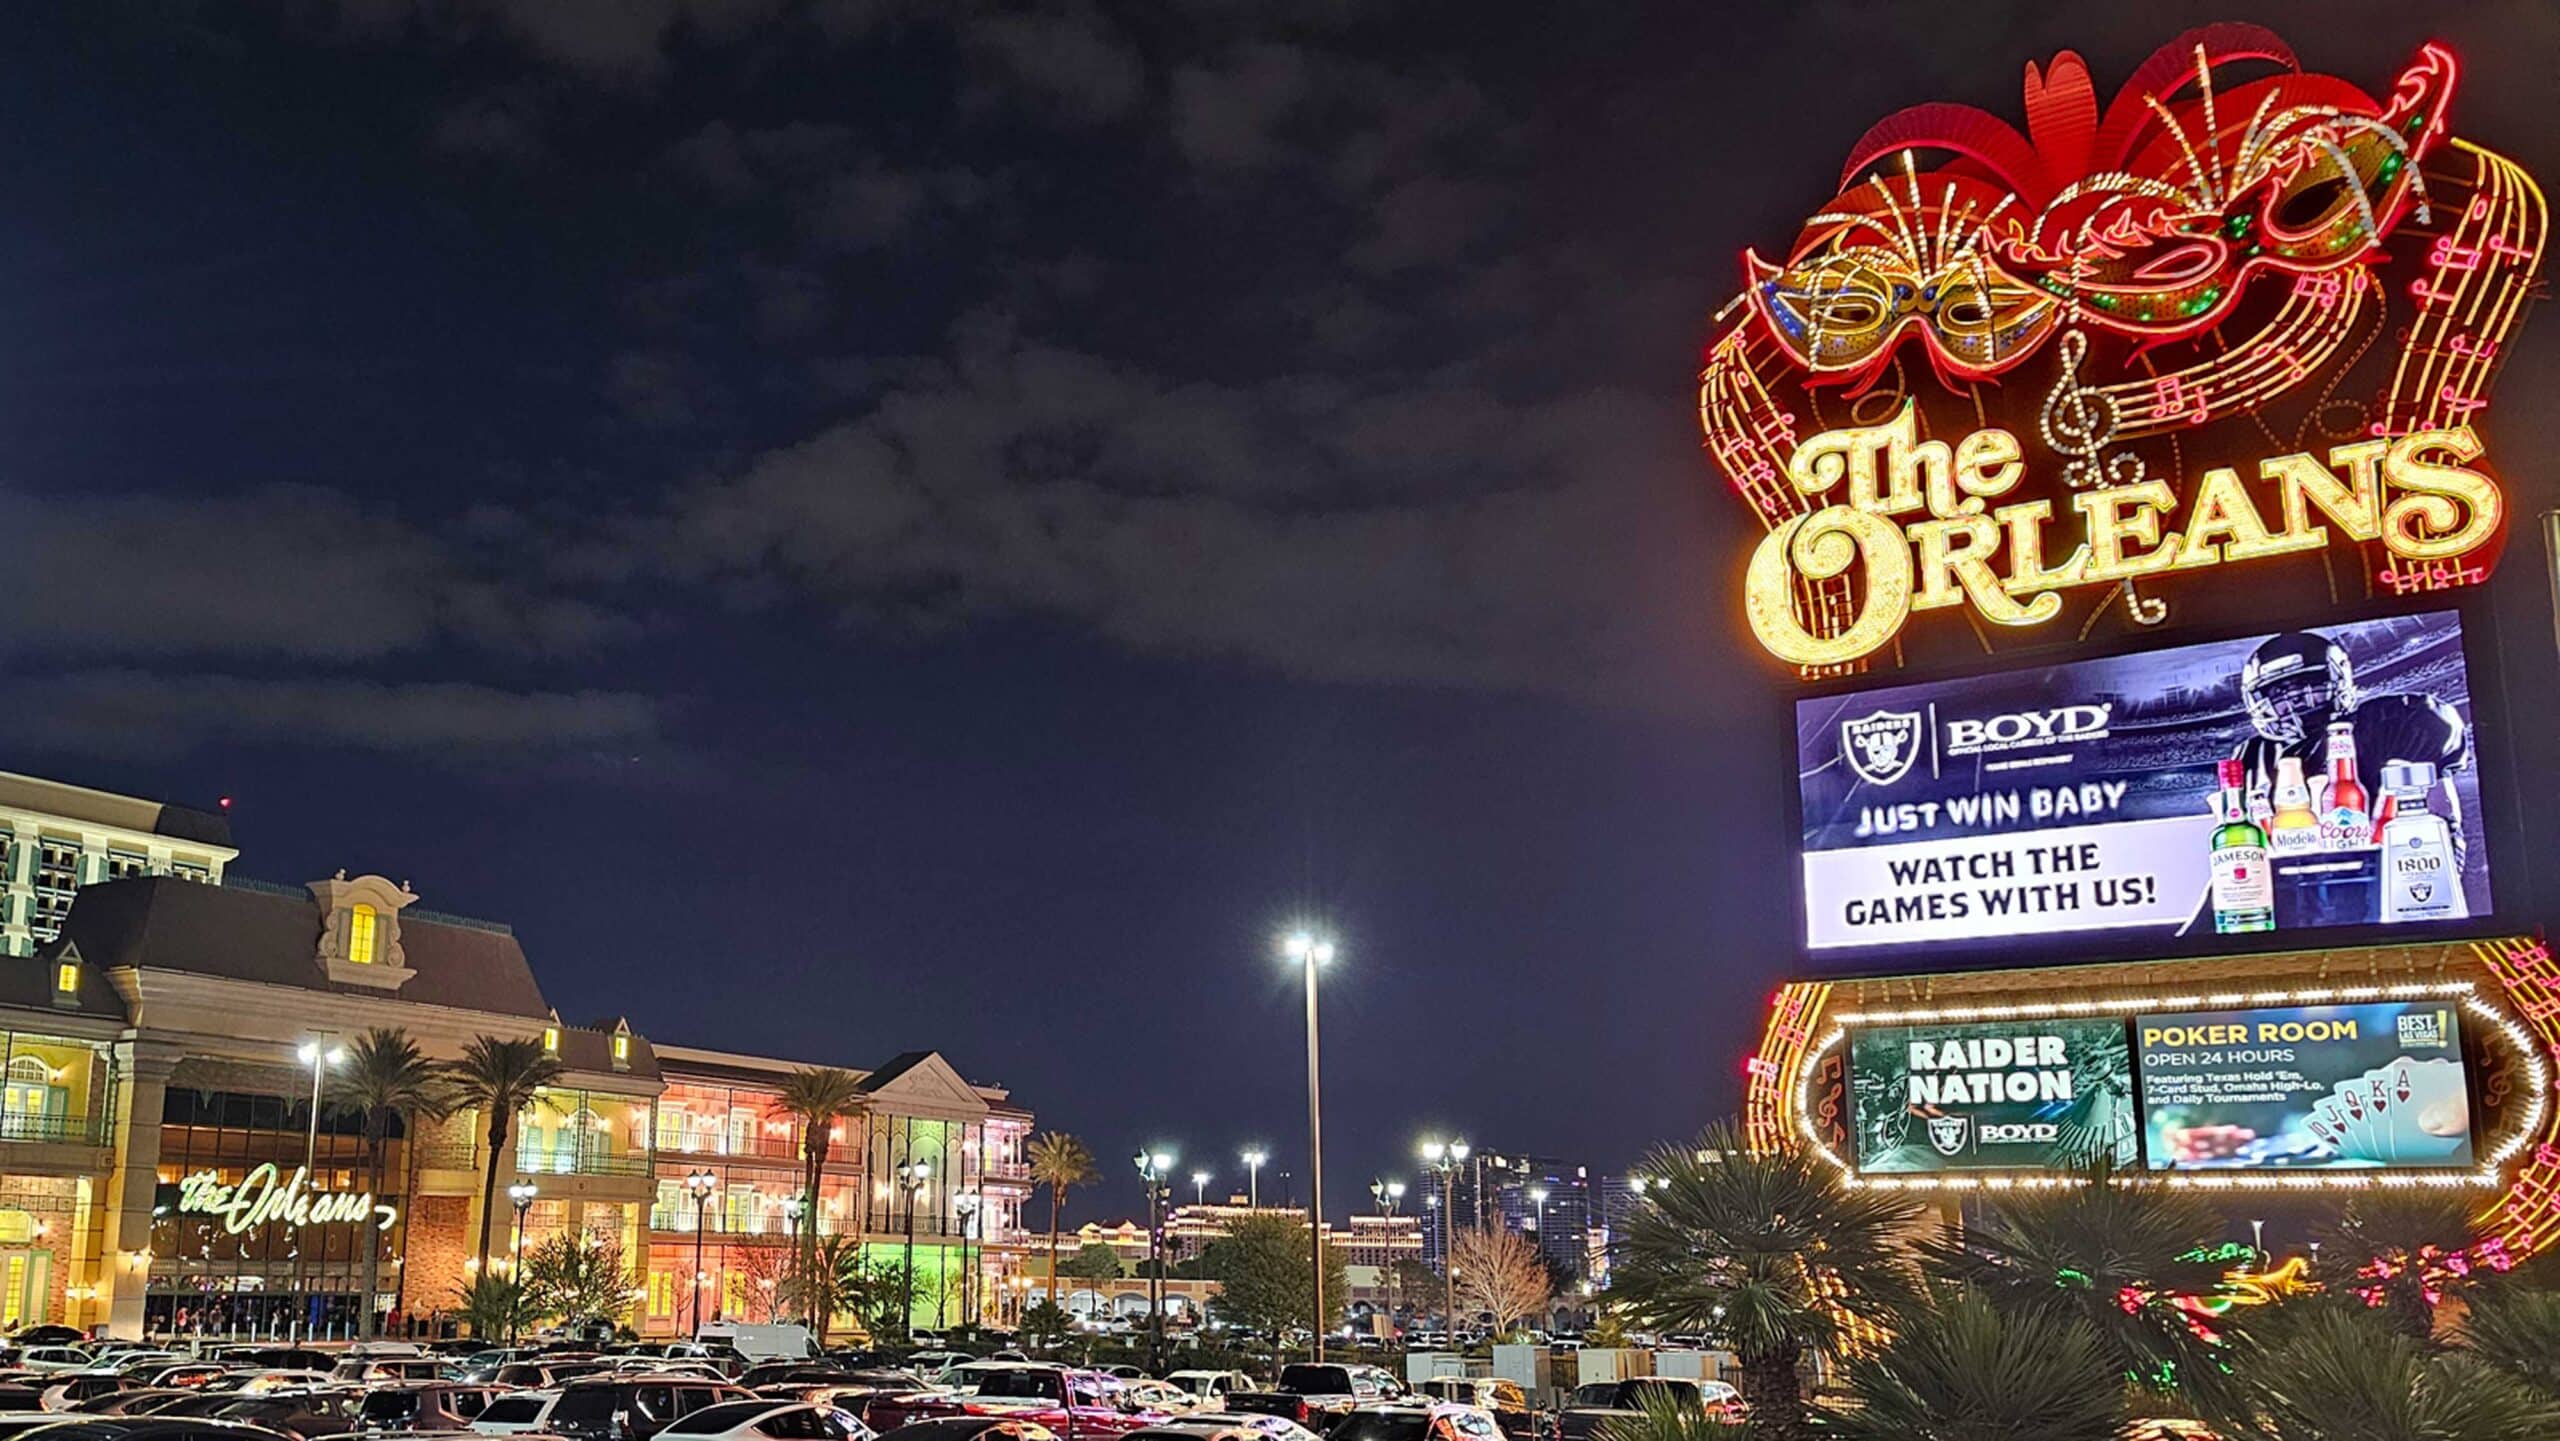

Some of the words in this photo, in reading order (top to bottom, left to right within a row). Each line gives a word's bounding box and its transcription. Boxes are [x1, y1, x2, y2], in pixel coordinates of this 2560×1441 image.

[1788, 395, 2024, 519] The
[1745, 425, 2503, 664] ORLEANS
[1946, 703, 2111, 748] BOYD
[1854, 803, 1940, 838] JUST
[1946, 789, 2020, 828] WIN
[2030, 780, 2127, 820] BABY
[2320, 820, 2369, 839] Coors
[2276, 831, 2317, 848] Modelo
[1888, 850, 2015, 887] WATCH
[2026, 843, 2101, 875] THE
[2213, 850, 2265, 867] JAMESON
[2397, 856, 2441, 872] 1800
[1845, 892, 1969, 926] GAMES
[1978, 882, 2080, 916] WITH
[2094, 876, 2156, 908] US!
[2397, 1014, 2435, 1032] BEST
[2143, 1024, 2249, 1048] POKER
[2258, 1020, 2358, 1043] ROOM
[1909, 1036, 2070, 1070] RAIDER
[2144, 1053, 2196, 1067] OPEN
[2200, 1051, 2223, 1065] 24
[2228, 1049, 2295, 1064] HOURS
[2146, 1073, 2204, 1085] Featuring
[2206, 1073, 2242, 1083] Texas
[2244, 1071, 2273, 1082] Hold
[2397, 1069, 2411, 1087] A
[1909, 1070, 2072, 1105] NATION
[2147, 1084, 2188, 1095] 7-Card
[2190, 1084, 2222, 1094] Stud,
[2223, 1082, 2268, 1092] Omaha
[2270, 1081, 2325, 1092] High-Lo,
[2371, 1080, 2387, 1098] K
[2147, 1095, 2170, 1104] and
[2172, 1094, 2203, 1105] Daily
[2205, 1092, 2287, 1103] Tournaments
[1979, 1124, 2059, 1140] BOYD
[179, 1168, 233, 1215] the
[224, 1162, 372, 1234] Orleans
